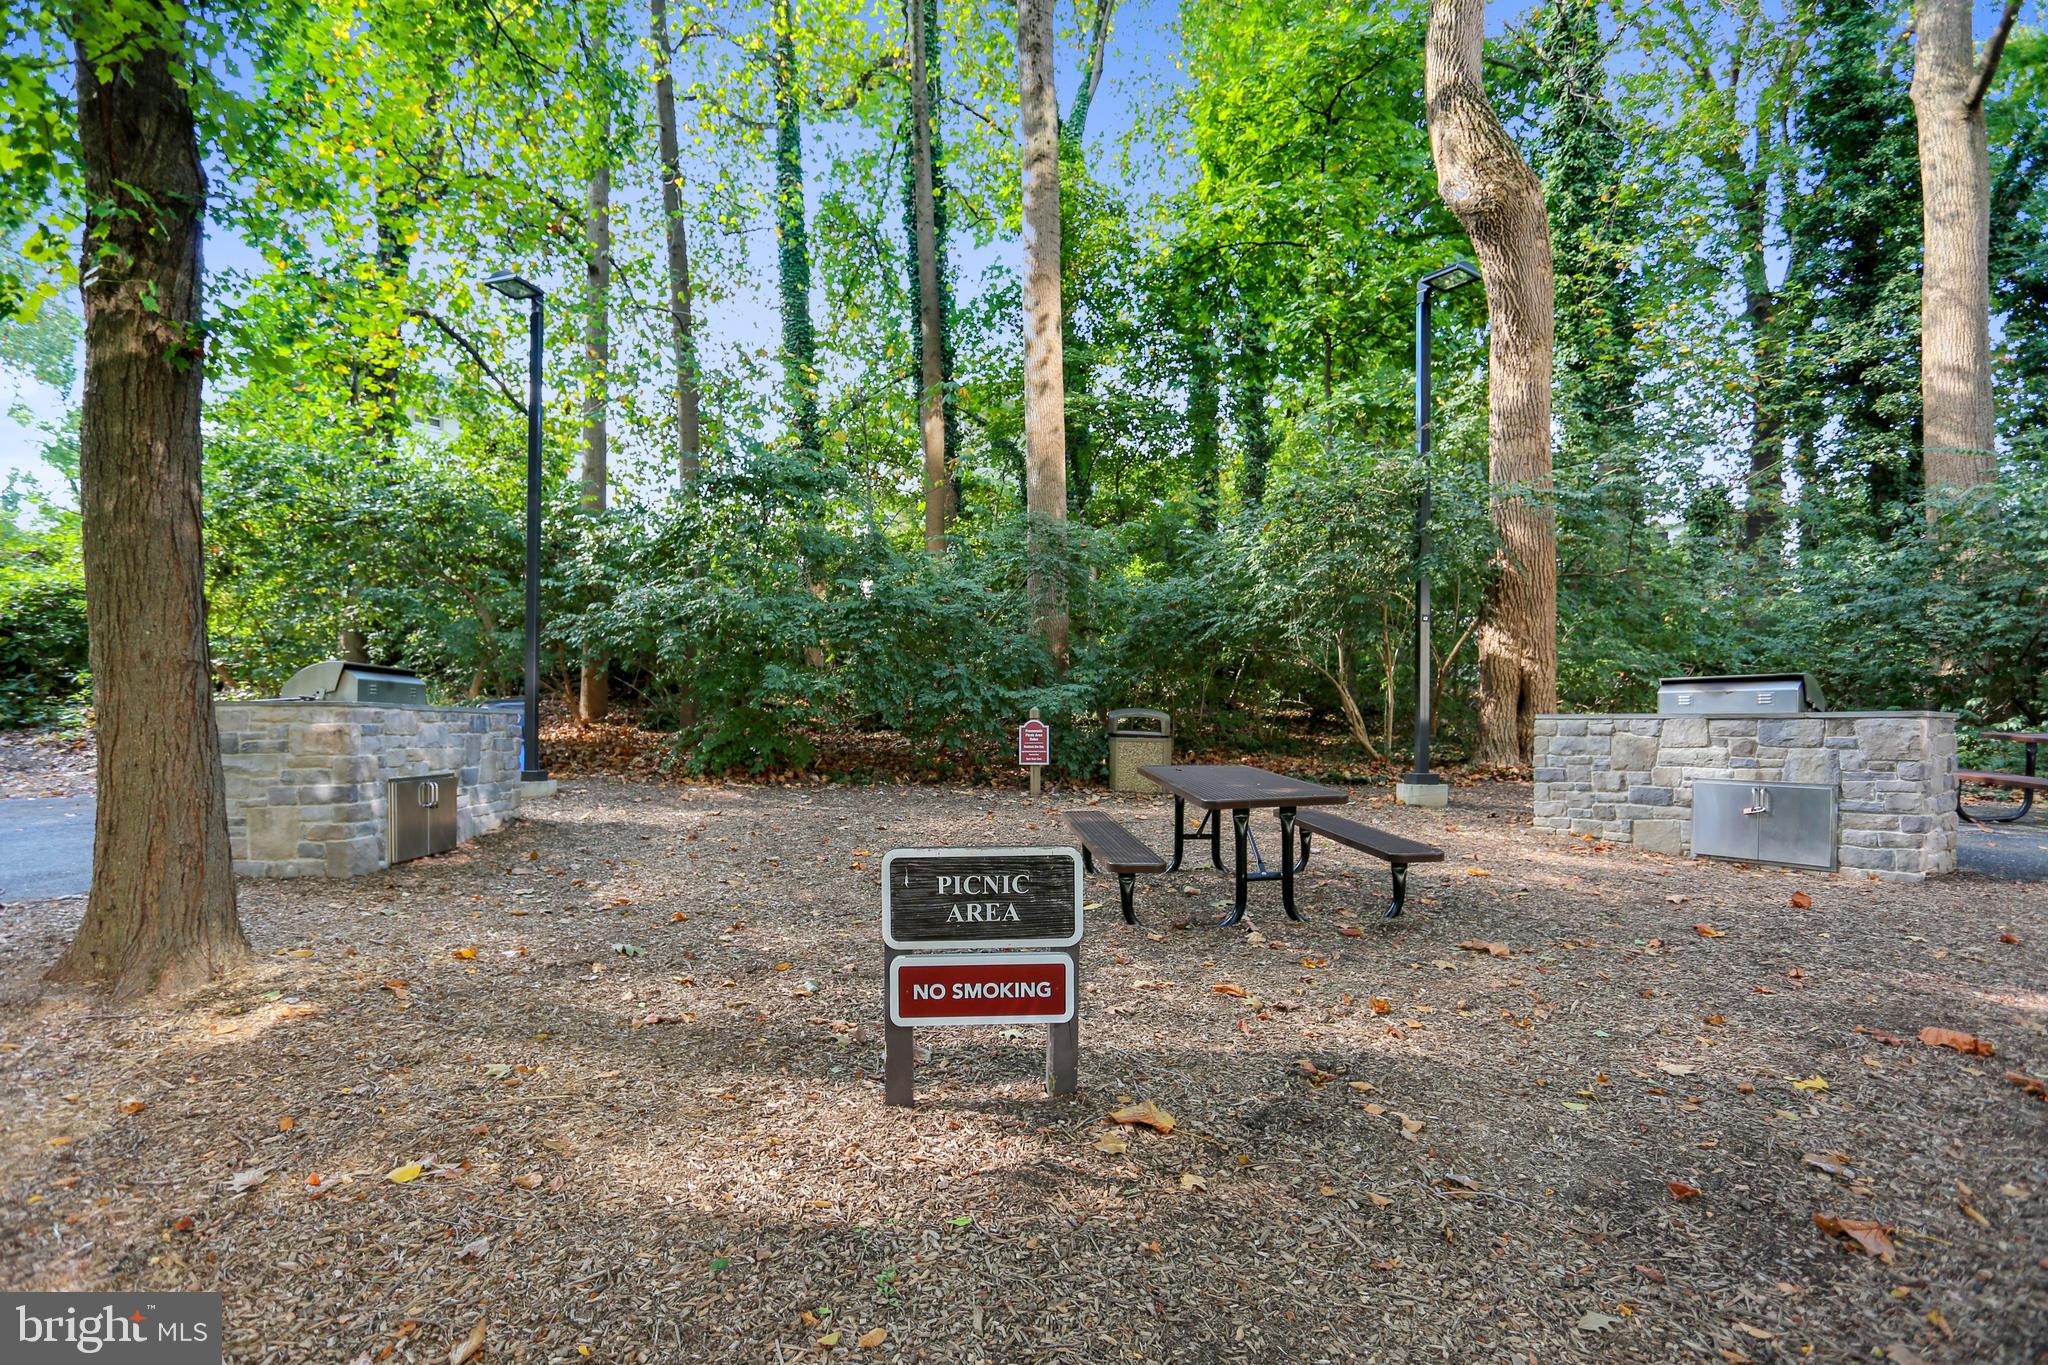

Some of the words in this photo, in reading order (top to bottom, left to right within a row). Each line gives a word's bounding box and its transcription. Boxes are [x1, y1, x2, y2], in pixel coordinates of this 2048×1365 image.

[936, 874, 1030, 895] PICNIC
[946, 903, 1020, 923] AREA
[913, 983, 946, 1000] NO
[952, 981, 1051, 999] SMOKING
